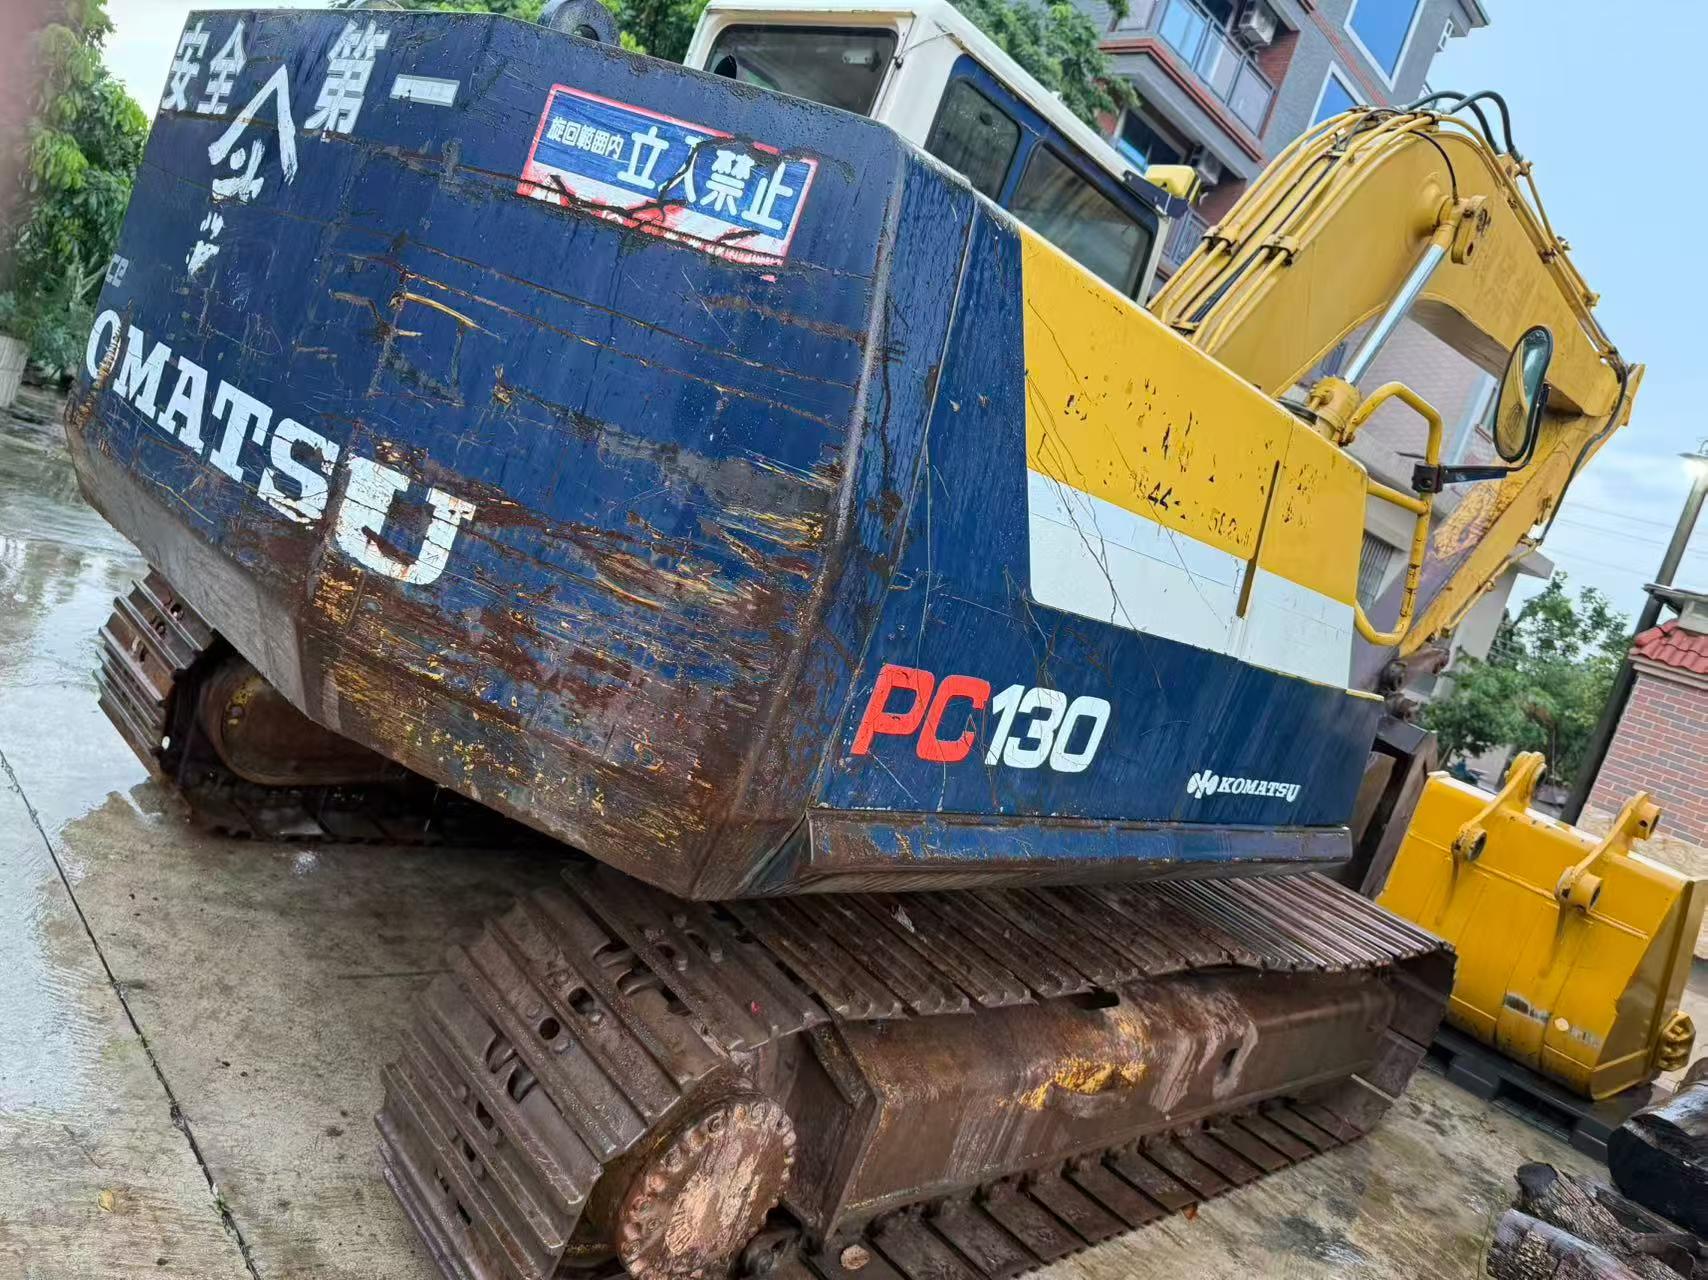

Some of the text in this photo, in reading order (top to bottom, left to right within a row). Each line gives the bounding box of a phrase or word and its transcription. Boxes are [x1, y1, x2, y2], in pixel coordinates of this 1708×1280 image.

[547, 116, 794, 230] 旋回範囲内 立入禁止
[850, 663, 1111, 773] PC130
[1217, 777, 1301, 802] KOMATSU
